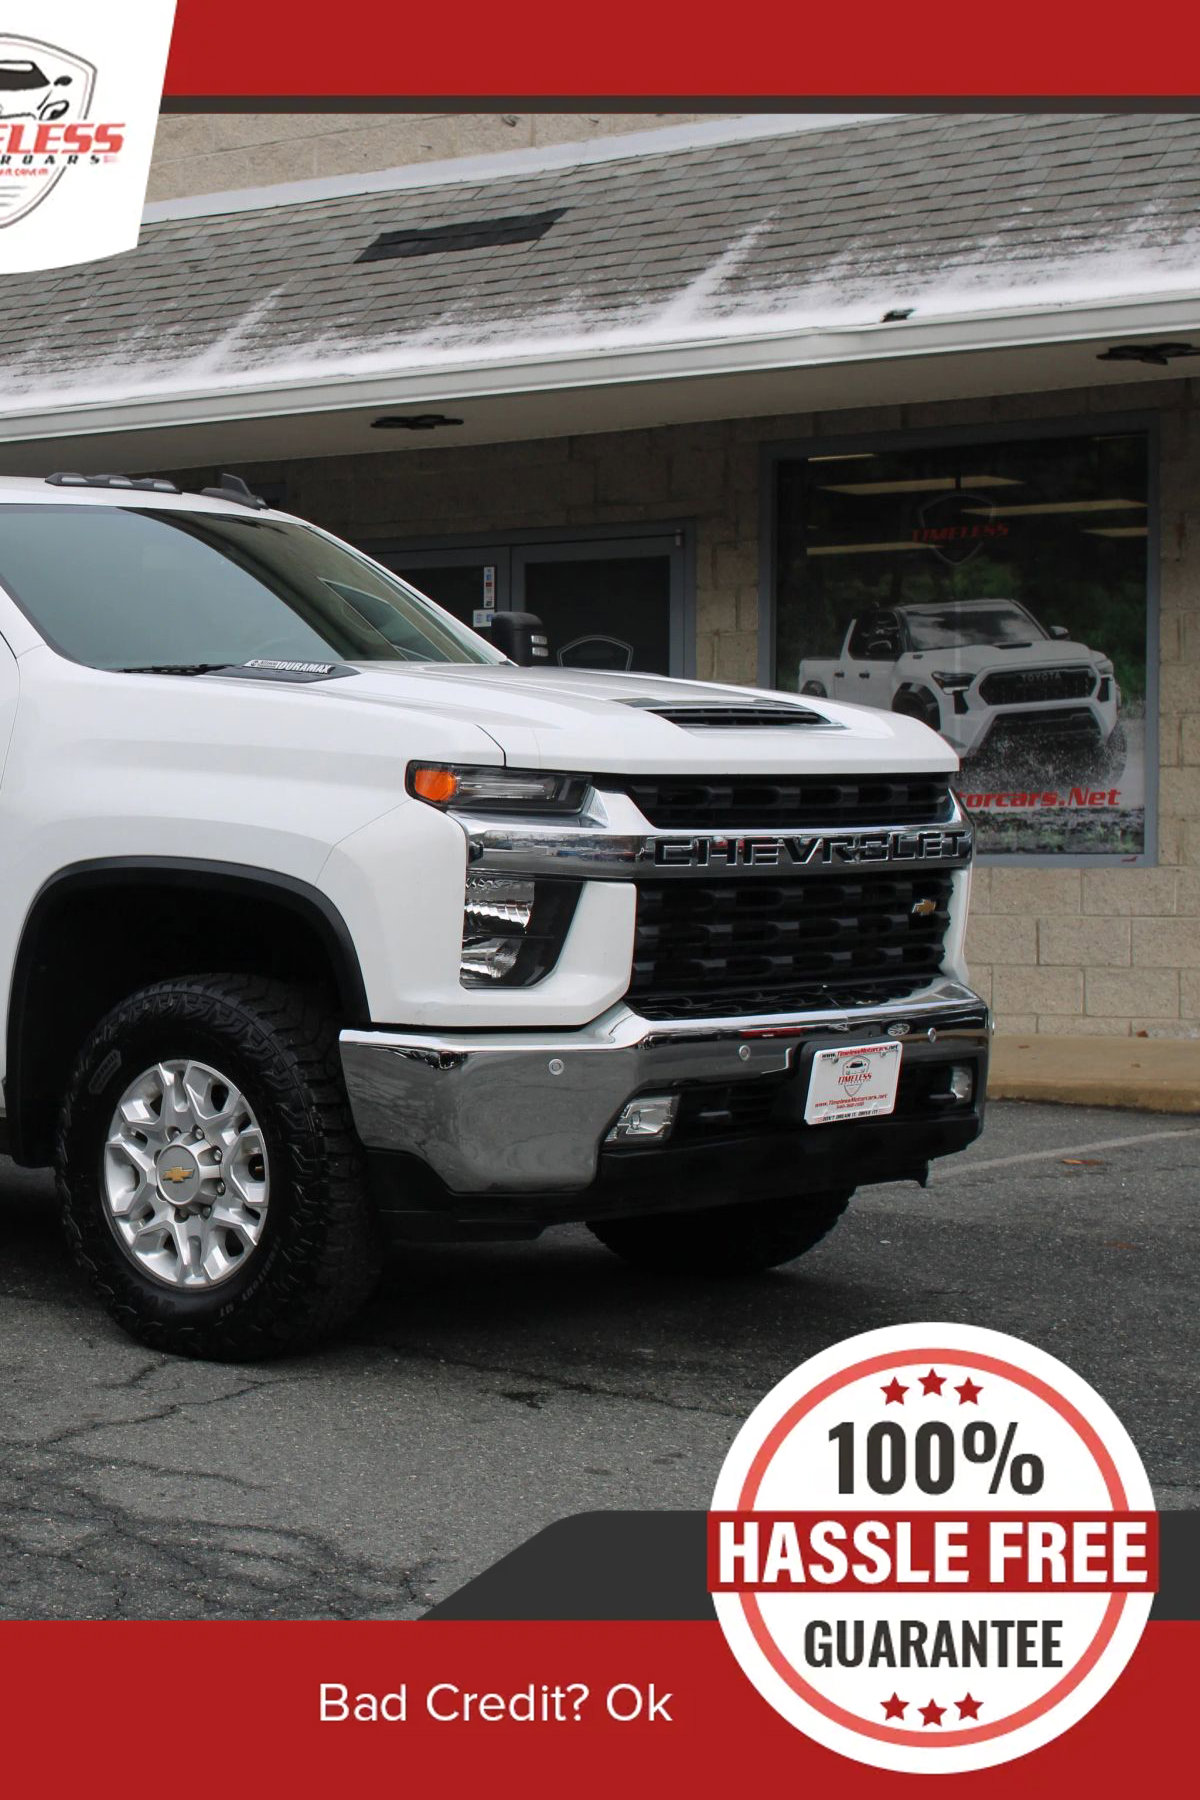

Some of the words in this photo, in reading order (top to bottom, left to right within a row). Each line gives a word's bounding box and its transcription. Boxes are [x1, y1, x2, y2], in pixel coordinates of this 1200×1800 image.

[912, 521, 1008, 542] TIMELESS
[279, 661, 332, 674] DURAMAX
[1022, 671, 1063, 682] TOYOTA
[654, 829, 973, 867] CHEVROLET
[838, 1072, 872, 1084] TIMELESS
